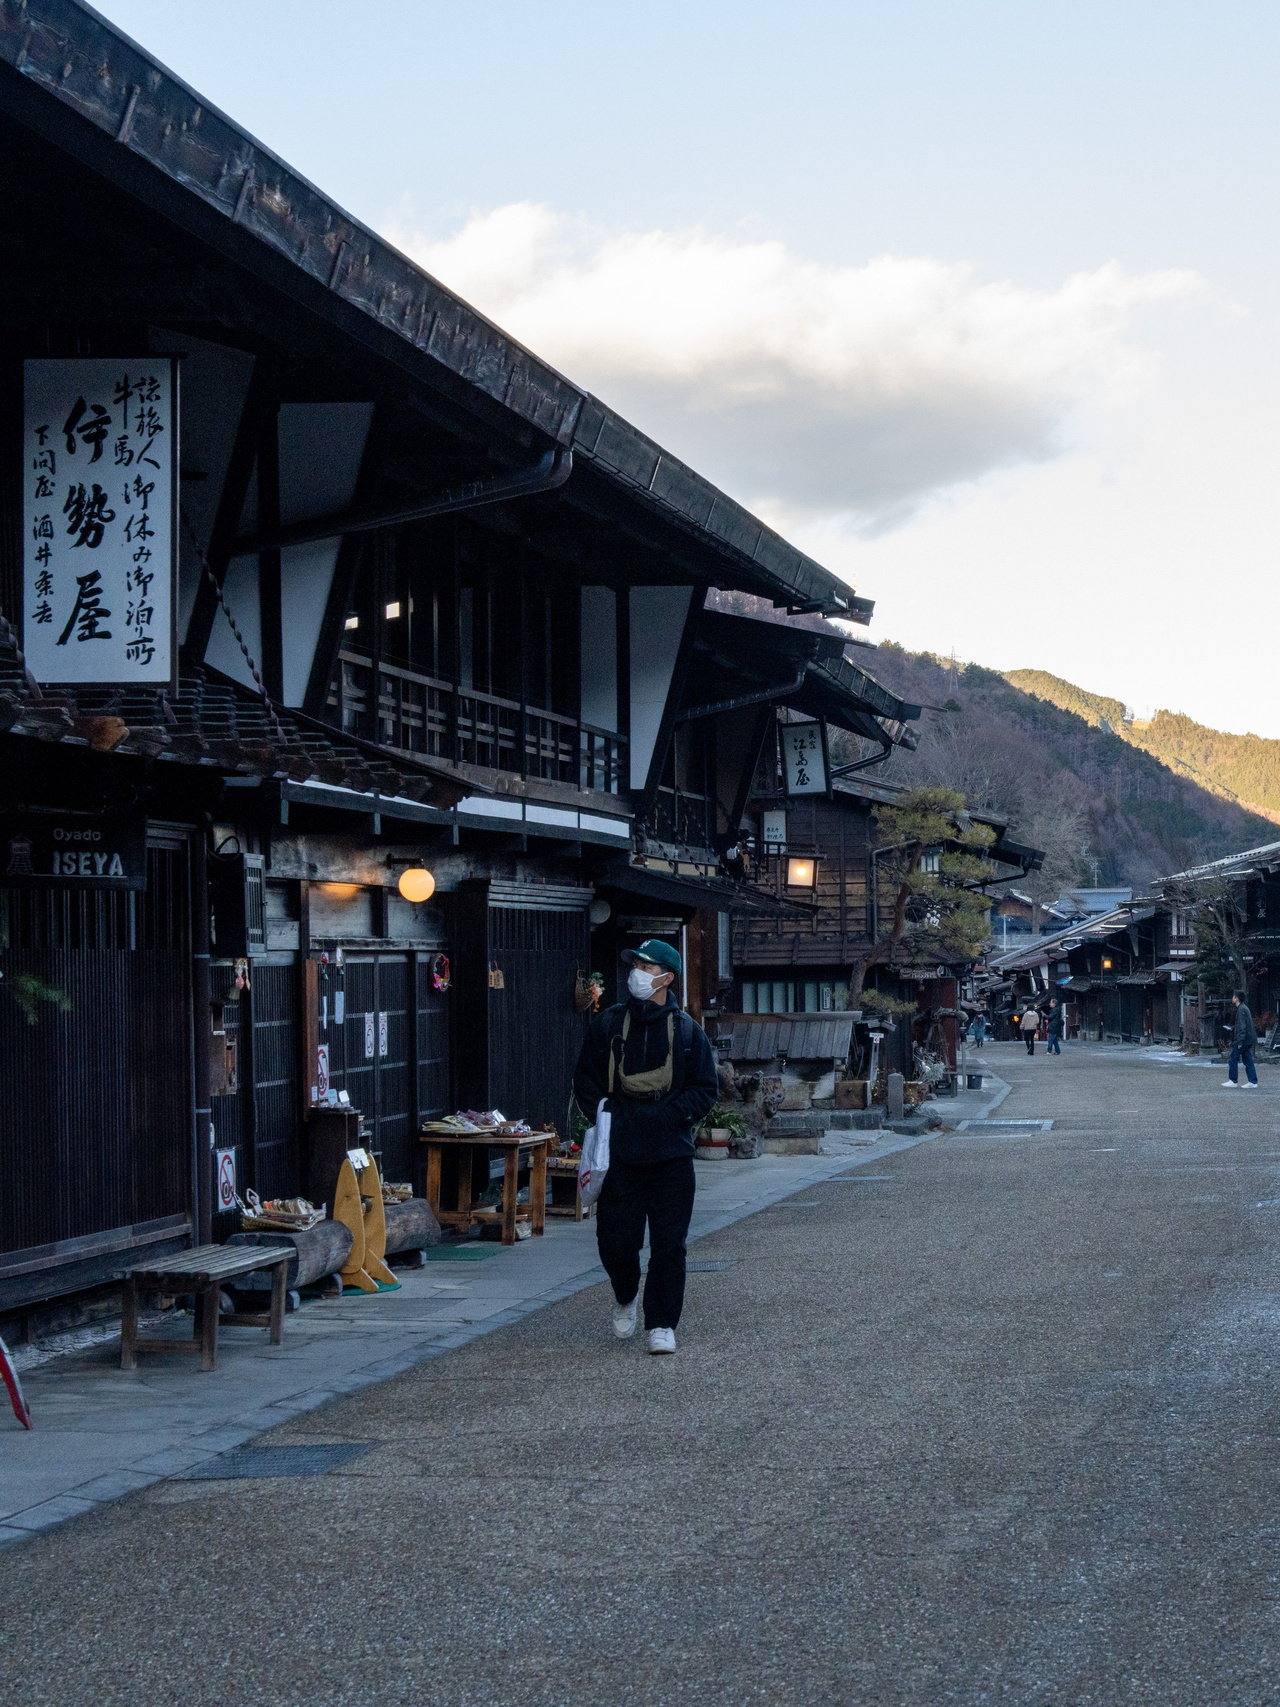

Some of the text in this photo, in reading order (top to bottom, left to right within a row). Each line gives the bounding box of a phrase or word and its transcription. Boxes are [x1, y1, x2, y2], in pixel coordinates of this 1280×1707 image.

[113, 373, 135, 467] 牛馬
[56, 396, 116, 647] 伊勢屋
[52, 827, 101, 842] Oyado
[52, 850, 124, 876] ISEYA
